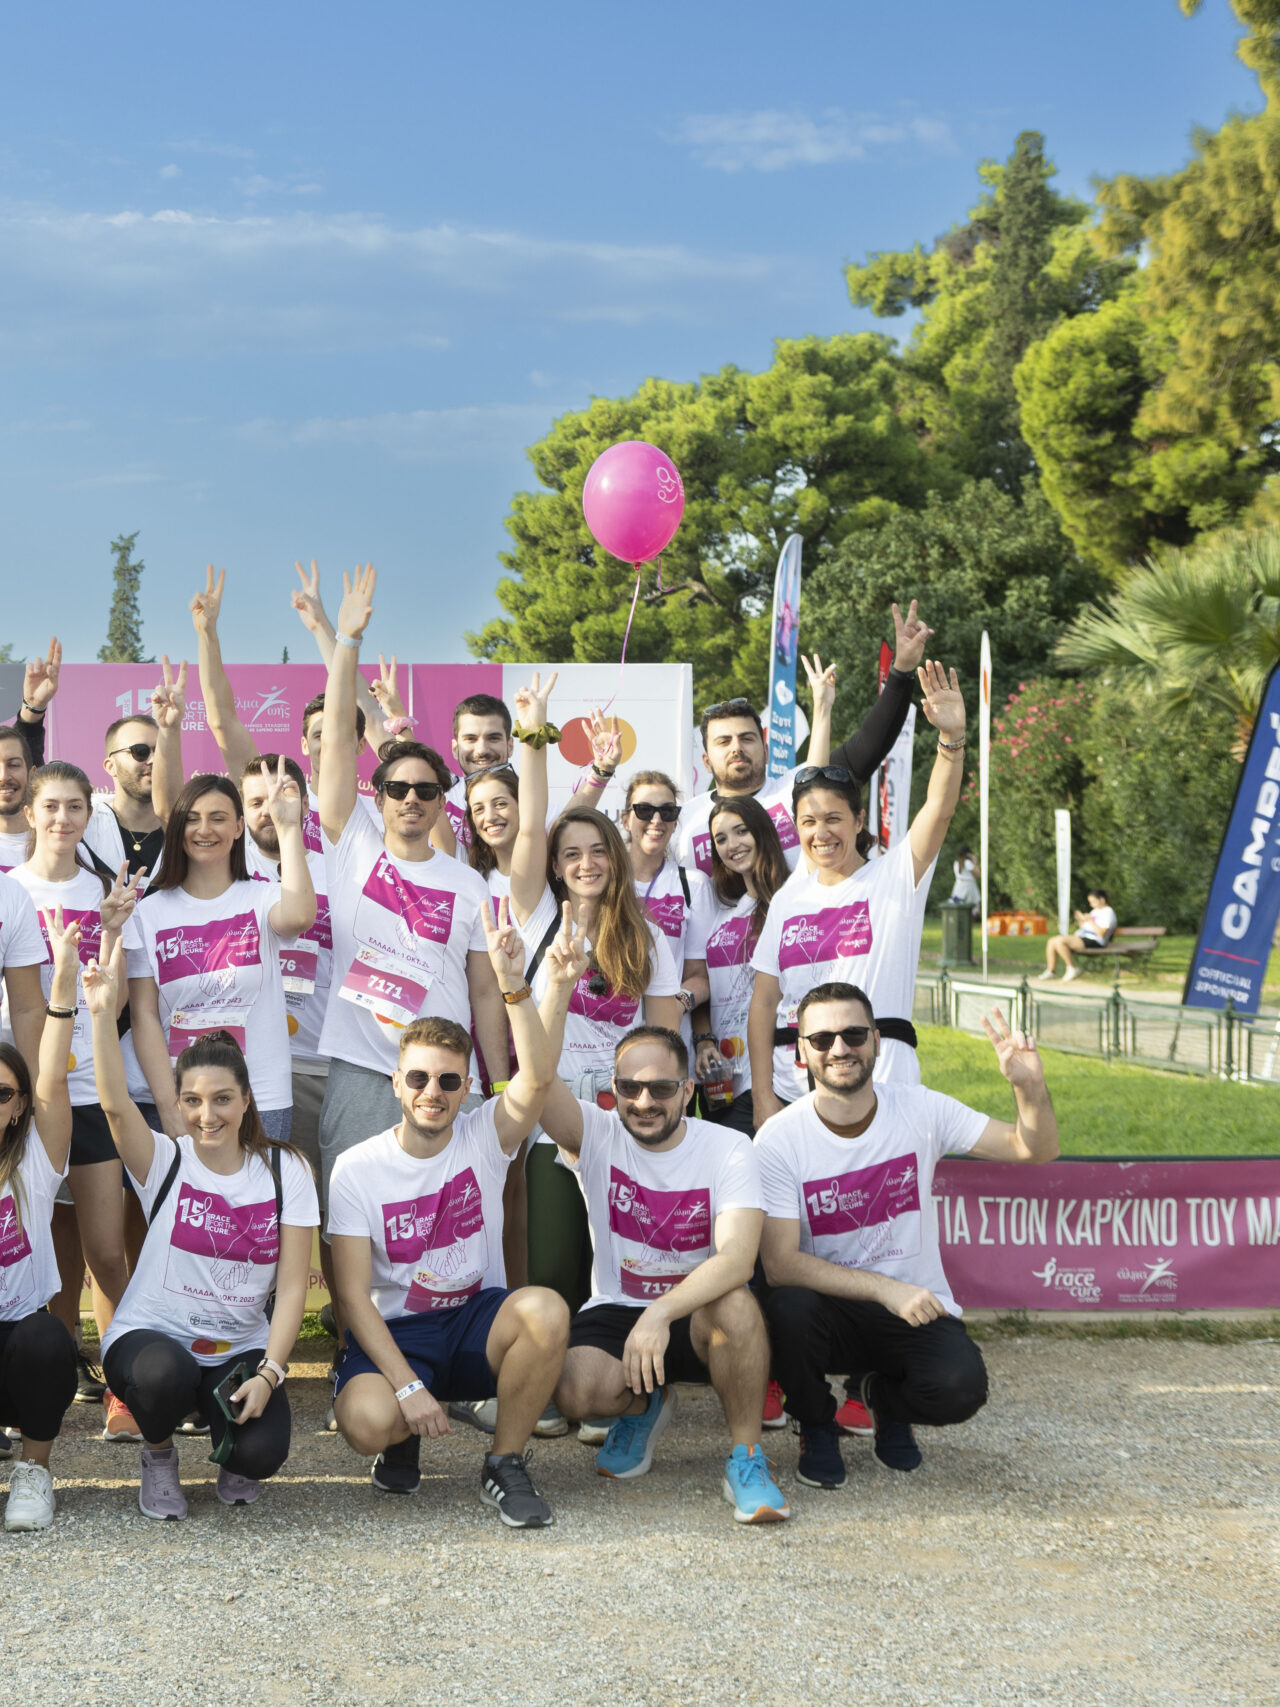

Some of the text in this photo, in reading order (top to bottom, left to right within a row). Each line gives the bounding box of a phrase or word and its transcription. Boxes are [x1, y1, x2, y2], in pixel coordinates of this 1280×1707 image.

[156, 937, 179, 963] 15
[369, 937, 396, 956] ΕΛΛΑΔΑ
[279, 959, 296, 971] 76
[1198, 967, 1251, 990] OFFICIAL
[368, 975, 404, 1000] 7171
[842, 1190, 862, 1198] RACE
[807, 1190, 837, 1216] 15
[180, 1198, 204, 1227] 15
[210, 1214, 231, 1223] RACE
[420, 1213, 437, 1223] RACE
[210, 1220, 237, 1231] FOR THE
[386, 1213, 414, 1241] 15
[931, 1196, 971, 1245] ΤΙΑ
[978, 1196, 1048, 1245] ΣΤΟΝ
[1056, 1197, 1178, 1246] ΚΑΡΚΙΝΟ
[1185, 1198, 1238, 1246] ΤΟΥ
[1054, 1273, 1095, 1287] race
[183, 1285, 214, 1297] ΕΛΛΑΔΑ
[1070, 1286, 1101, 1297] cure
[430, 1295, 469, 1308] 7162
